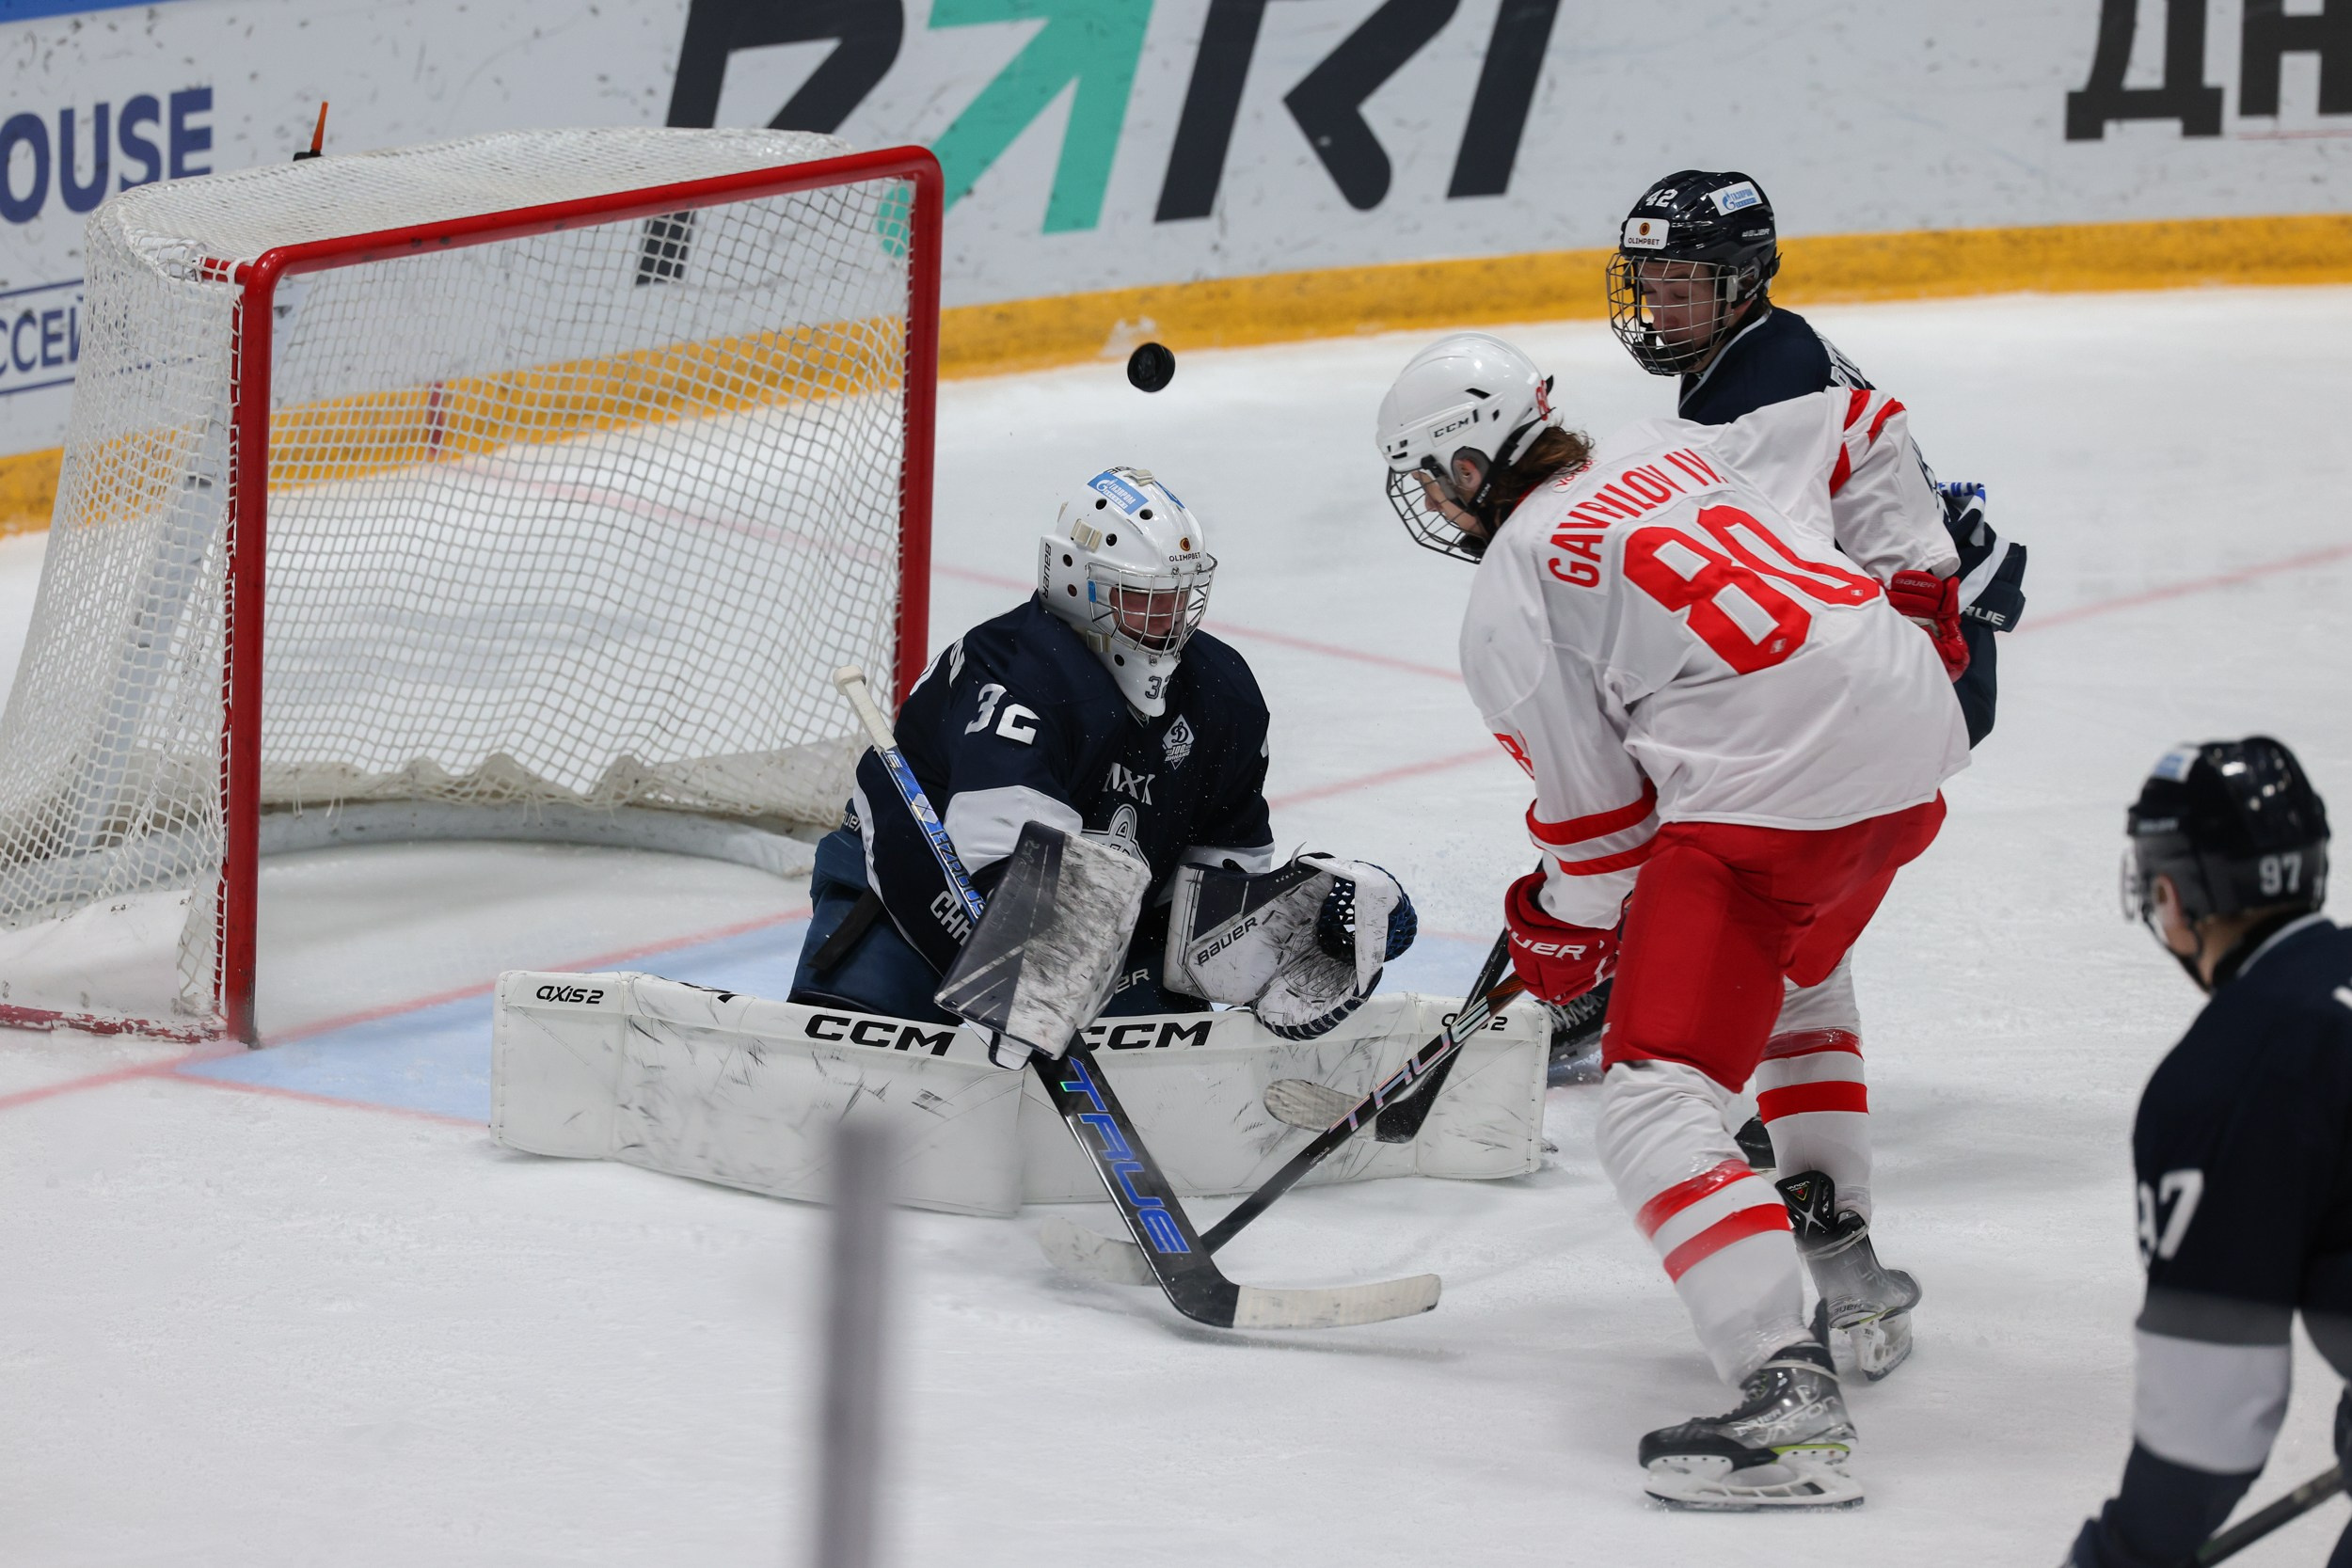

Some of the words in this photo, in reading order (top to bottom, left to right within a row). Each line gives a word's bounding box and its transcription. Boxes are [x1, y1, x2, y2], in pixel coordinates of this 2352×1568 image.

[1645, 188, 1678, 208] 42
[1628, 237, 1661, 246] OLIMPBET
[1433, 417, 1470, 439] CCM
[1168, 551, 1201, 562] OLIMPBET
[1622, 503, 1882, 676] 80
[1963, 605, 2006, 626] RUE
[964, 683, 1041, 746] 32
[2259, 851, 2302, 895] 97
[1507, 926, 1588, 961] UER
[803, 1014, 957, 1057] CCM
[1059, 1055, 1191, 1256] TRUE
